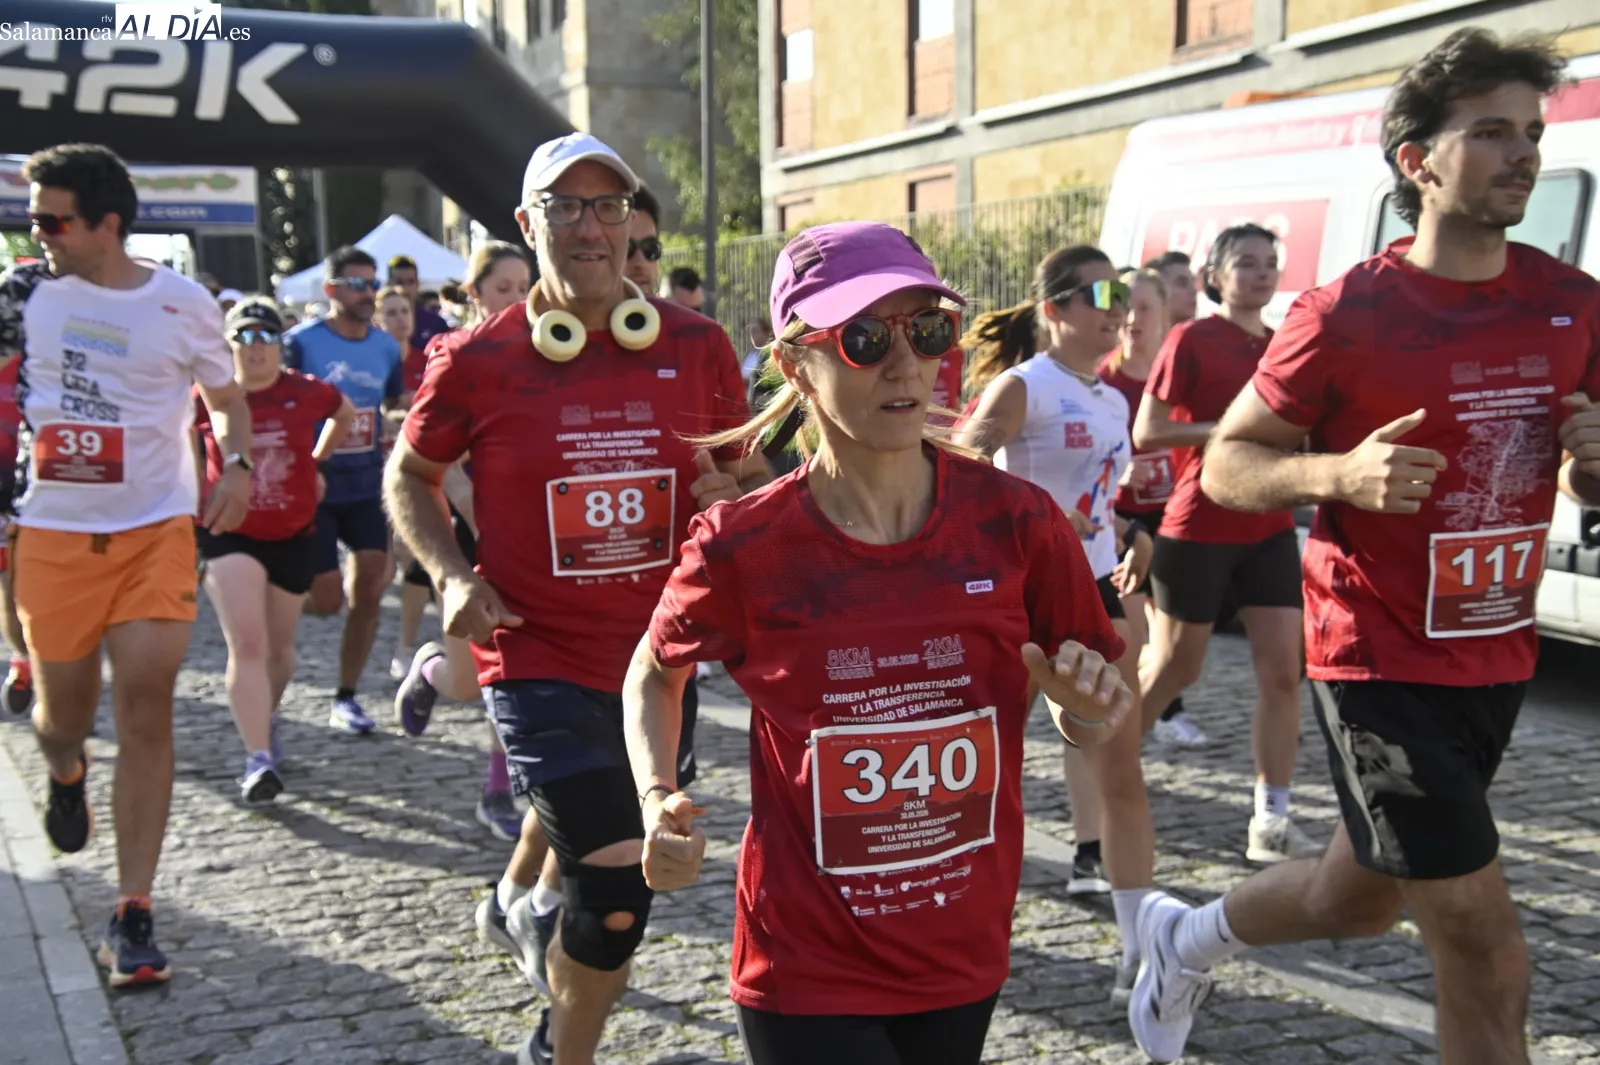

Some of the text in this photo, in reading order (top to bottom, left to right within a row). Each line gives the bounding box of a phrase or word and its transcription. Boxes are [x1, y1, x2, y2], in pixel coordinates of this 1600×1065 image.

[61, 349, 87, 371] 32
[60, 394, 121, 422] CROSS
[56, 429, 103, 456] 39
[584, 487, 646, 528] 88
[1451, 540, 1534, 586] 117
[827, 647, 871, 667] 8KM
[922, 634, 964, 657] 2KM
[828, 667, 875, 680] CARRERA
[823, 675, 971, 704] CARRERA POR LA INVESTIGACIÓN
[832, 699, 964, 723] UNIVERSIDAD DE SALAMANCA
[851, 690, 945, 715] Y LA TRANSFERENCIA
[842, 737, 978, 804] 340
[903, 800, 926, 811] 8KM
[862, 825, 893, 834] CARRERA
[894, 824, 908, 833] POR
[909, 822, 918, 830] LA
[881, 826, 946, 843] Y LA TRANSFERENCIA
[868, 830, 957, 854] UNIVERSIDAD DE SALAMANCA
